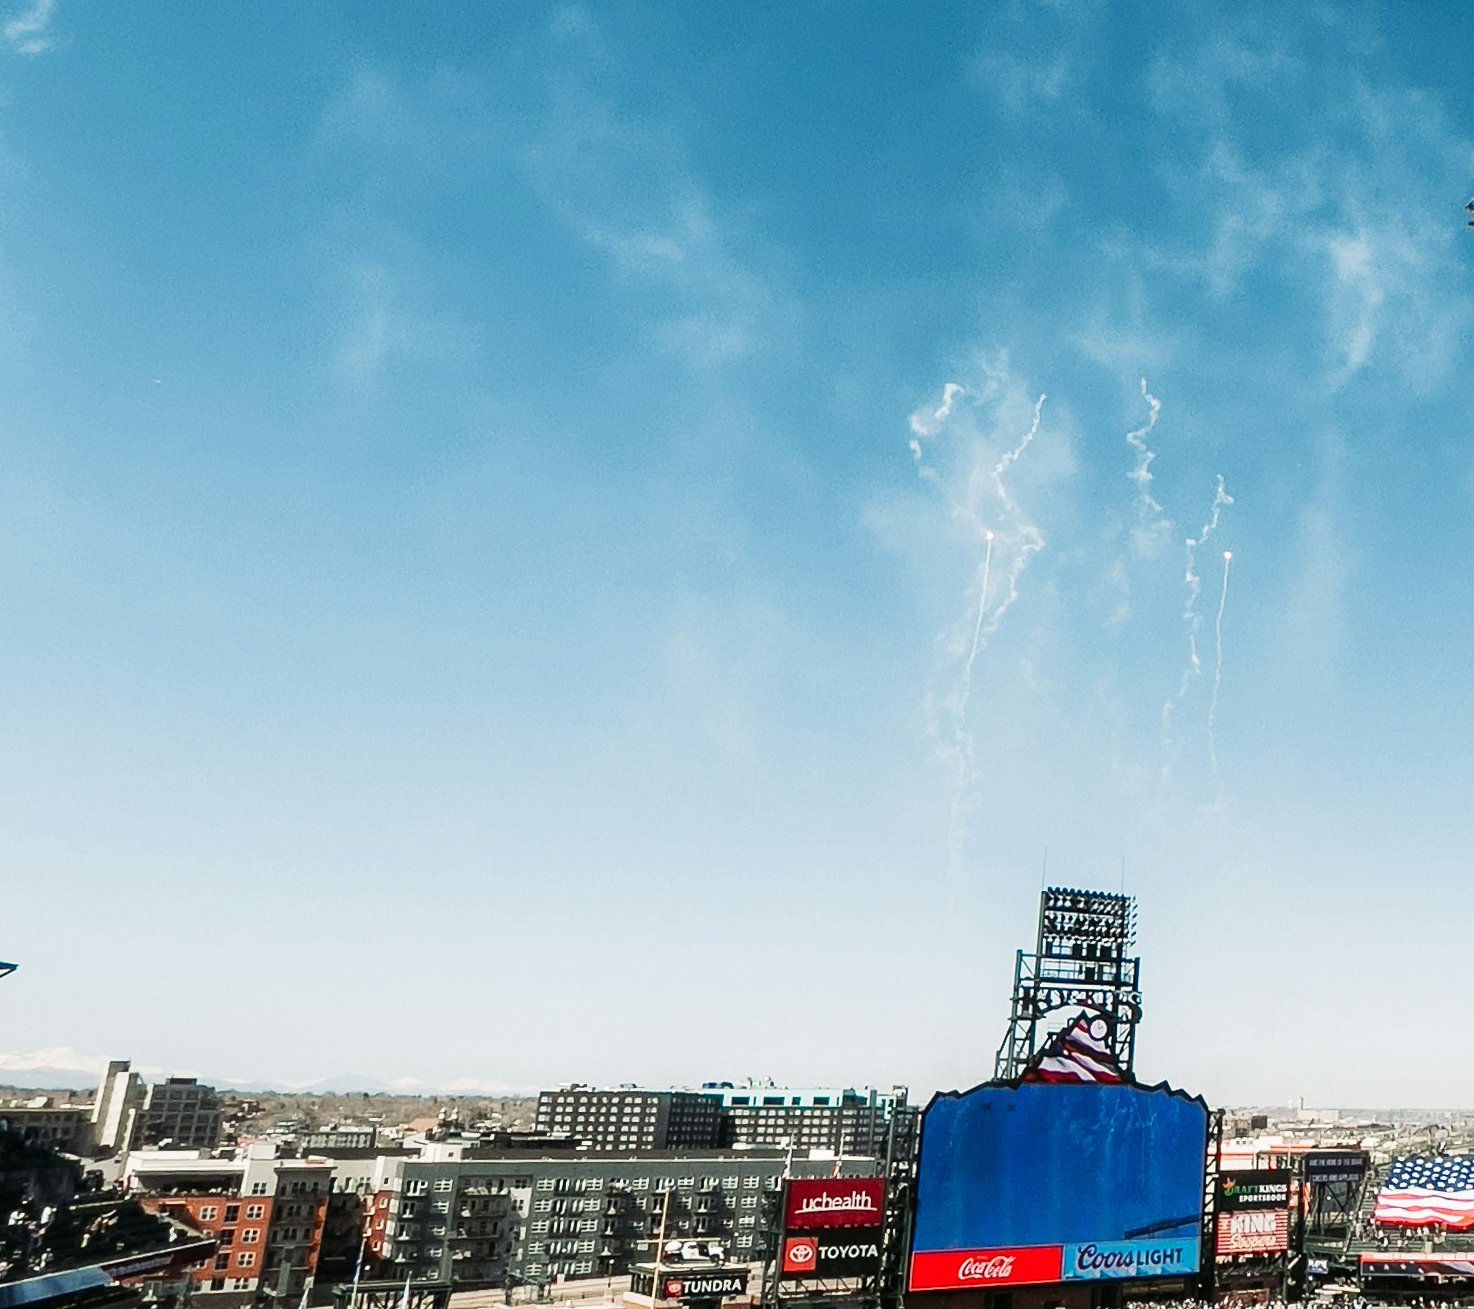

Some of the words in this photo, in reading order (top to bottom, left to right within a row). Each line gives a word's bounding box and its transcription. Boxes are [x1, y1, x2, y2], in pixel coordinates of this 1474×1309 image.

[802, 1190, 872, 1210] uchealth
[1239, 1194, 1286, 1203] SPORTSBOOK
[818, 1244, 878, 1259] TOYOTA
[1078, 1244, 1135, 1270] Coors
[1137, 1248, 1183, 1266] LIGHT
[683, 1279, 742, 1294] TUNDRA
